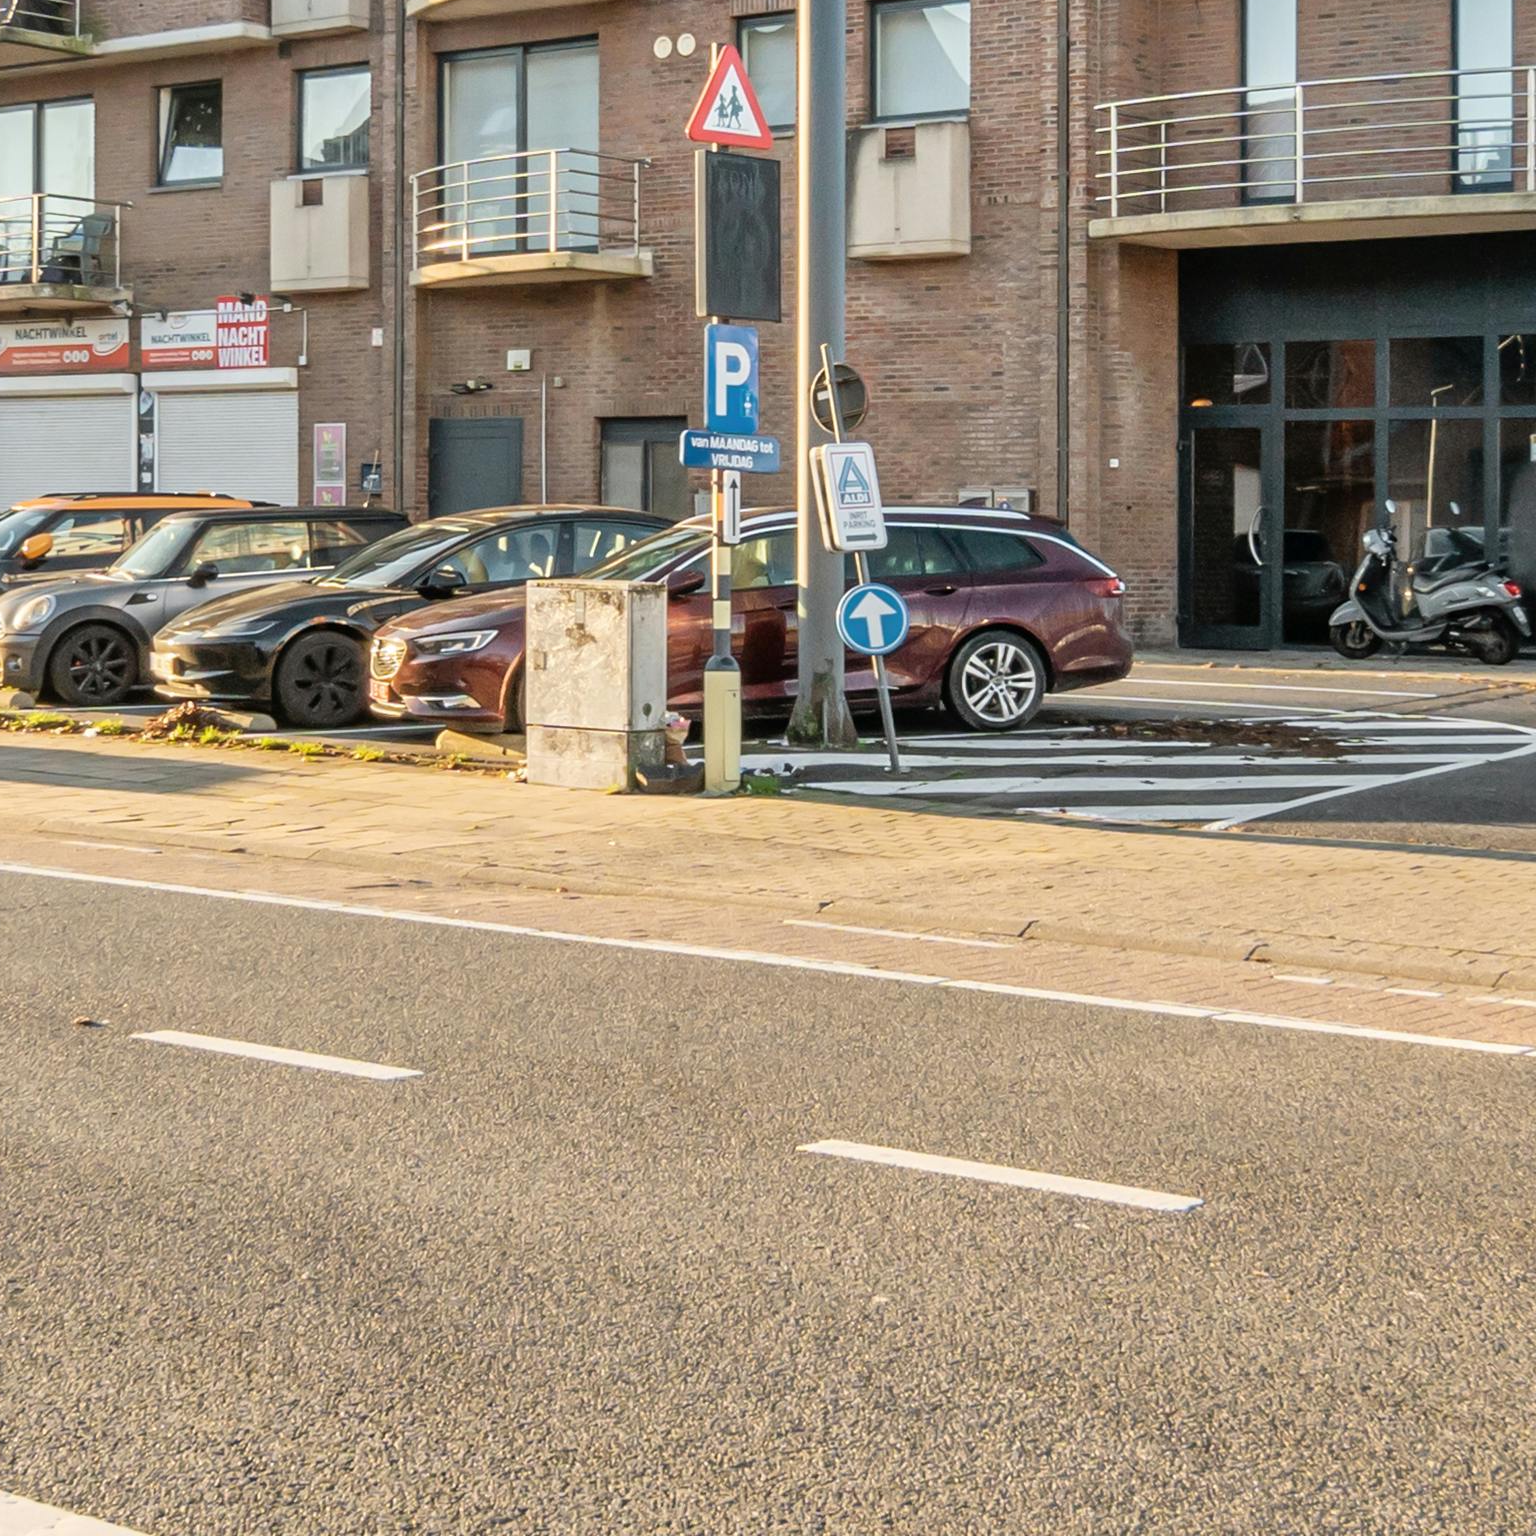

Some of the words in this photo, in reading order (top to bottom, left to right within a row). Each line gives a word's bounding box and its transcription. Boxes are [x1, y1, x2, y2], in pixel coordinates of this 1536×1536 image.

[218, 300, 268, 324] MAND
[15, 326, 88, 341] NACHTWINKEL
[151, 332, 212, 345] NACHTWINKEL
[217, 325, 267, 346] NACHT
[217, 345, 267, 368] WINKEL
[715, 341, 752, 417] P
[690, 436, 709, 448] van
[710, 436, 759, 453] MAANDAG
[760, 441, 774, 454] tot
[711, 452, 753, 469] VRIJDAG
[843, 492, 869, 504] ALDI
[843, 519, 876, 529] PARKING
